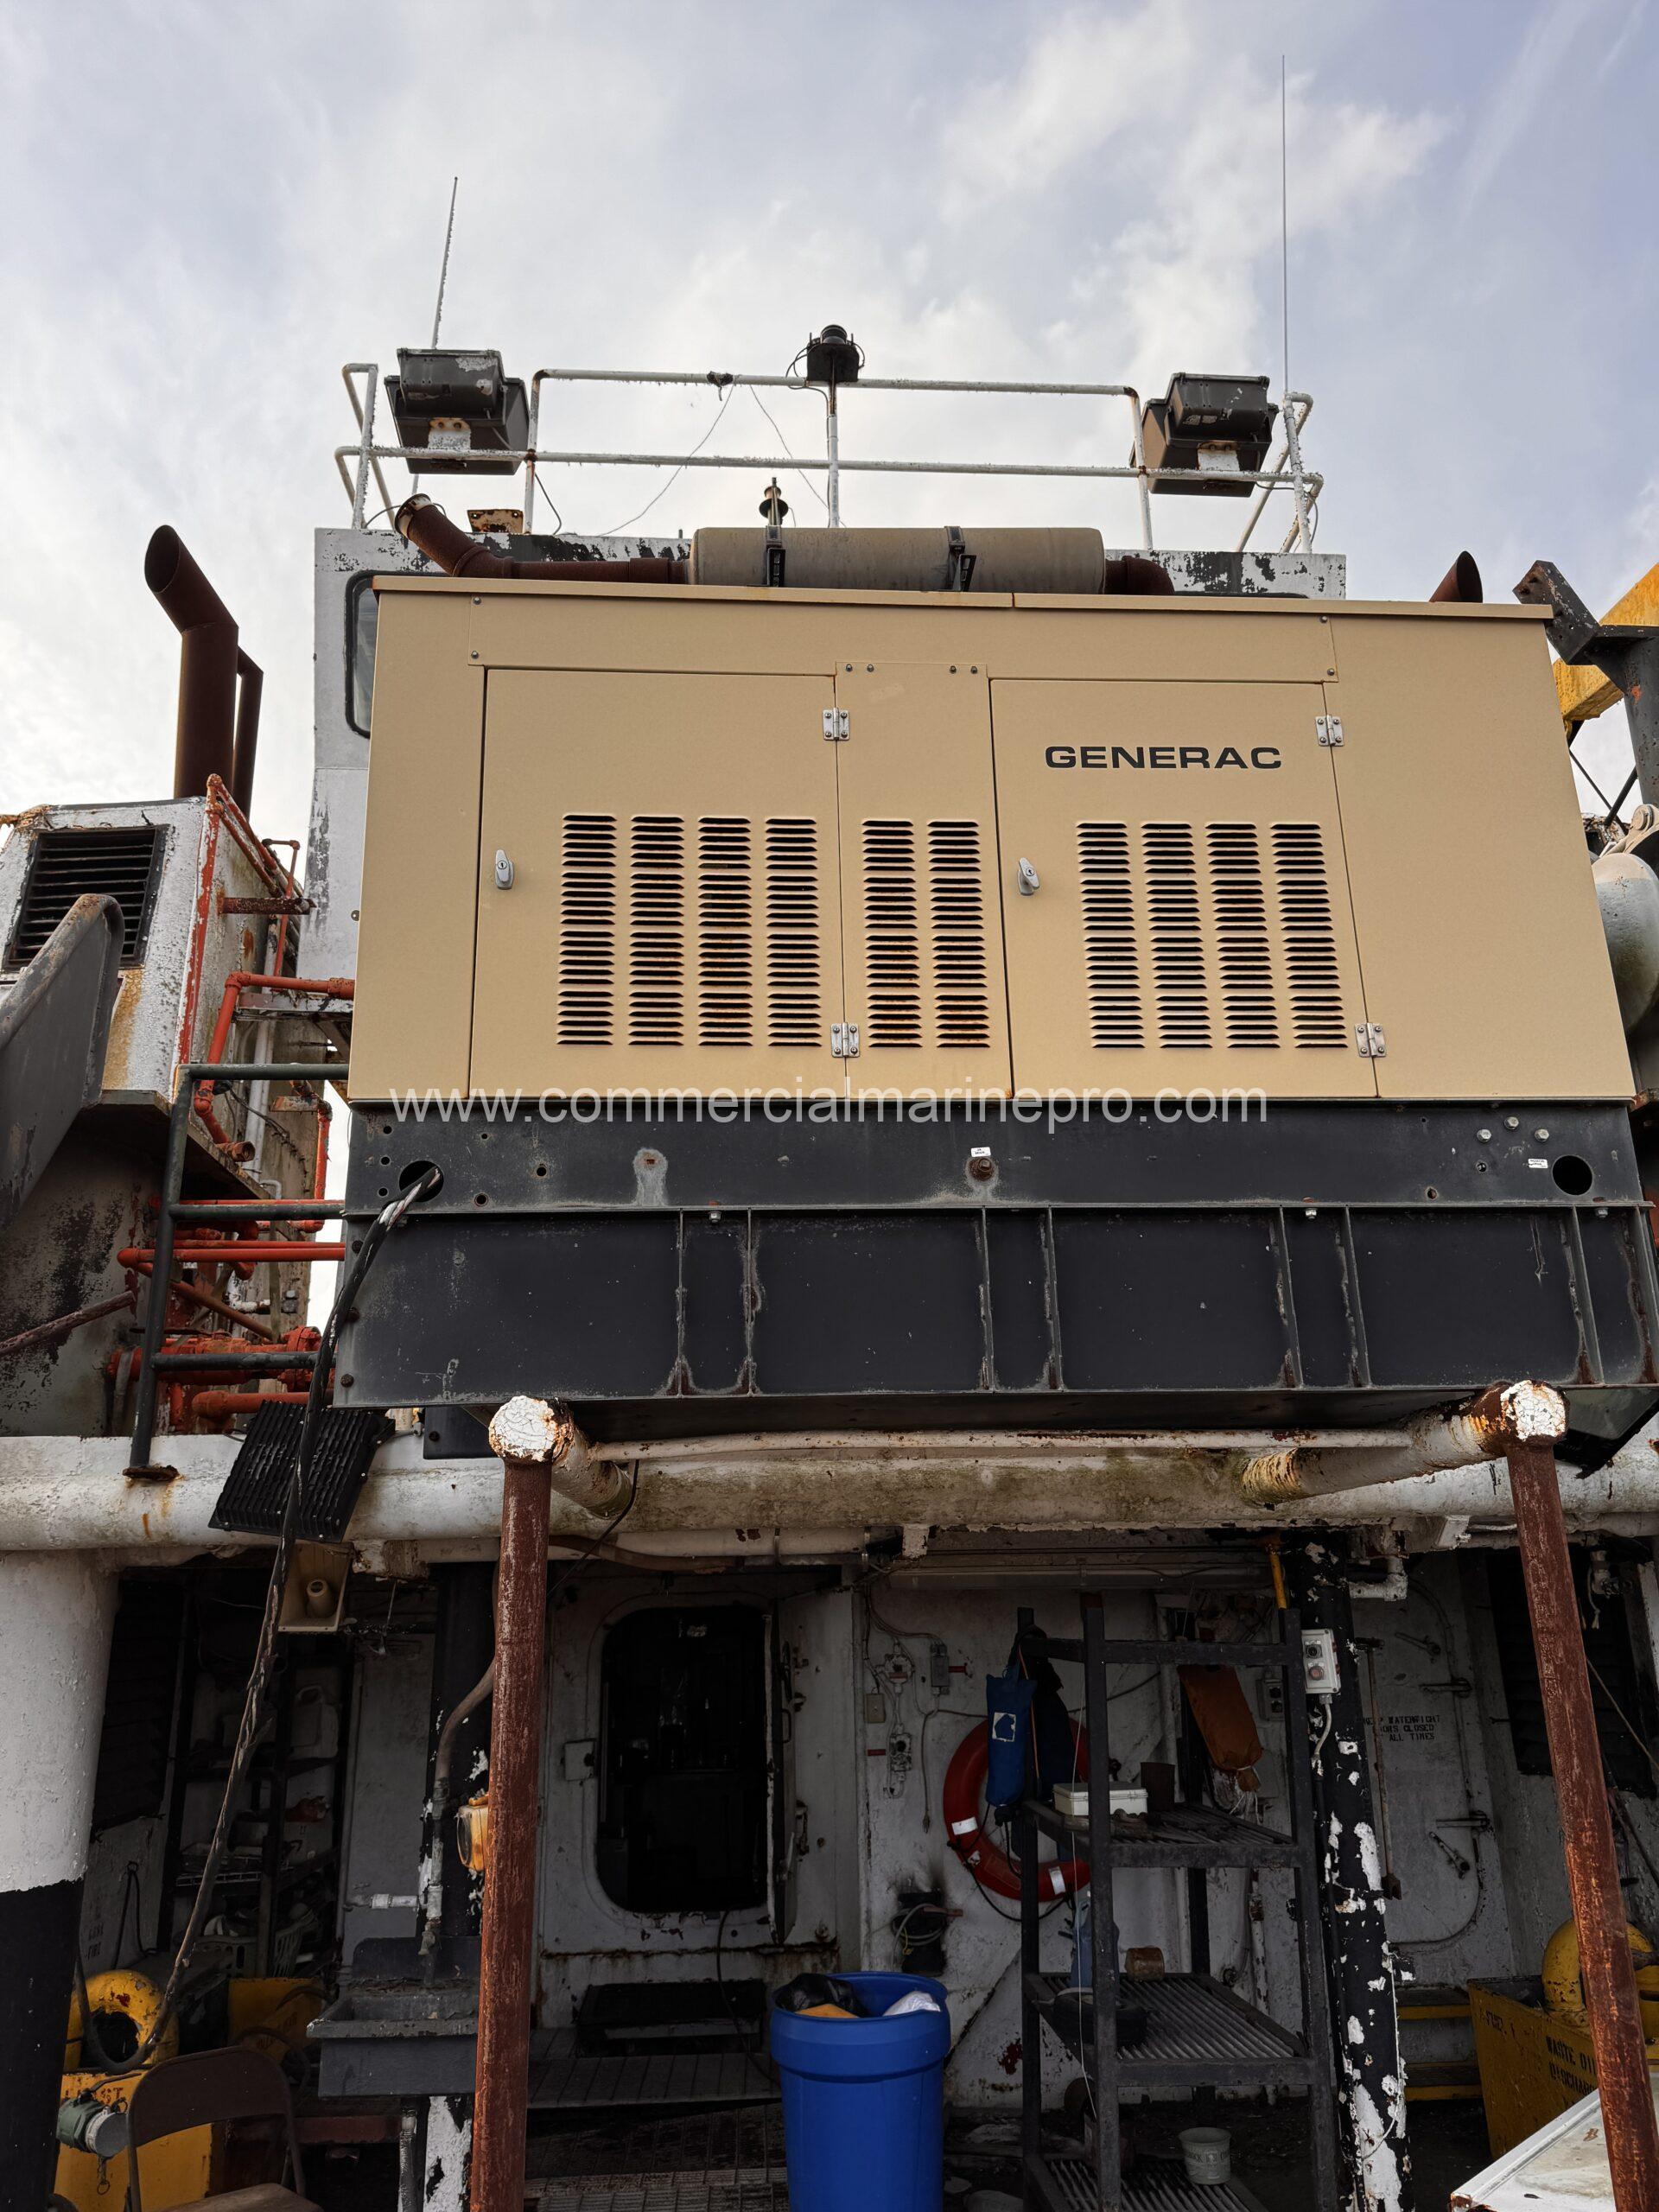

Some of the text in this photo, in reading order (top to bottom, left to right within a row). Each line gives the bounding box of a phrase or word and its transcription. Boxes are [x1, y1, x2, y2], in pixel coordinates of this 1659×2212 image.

[1045, 746, 1282, 769] GENERAC
[1403, 1723, 1434, 1732] CLOSED
[1389, 1732, 1435, 1742] ALL TIMES
[1546, 2035, 1576, 2066] WASTE
